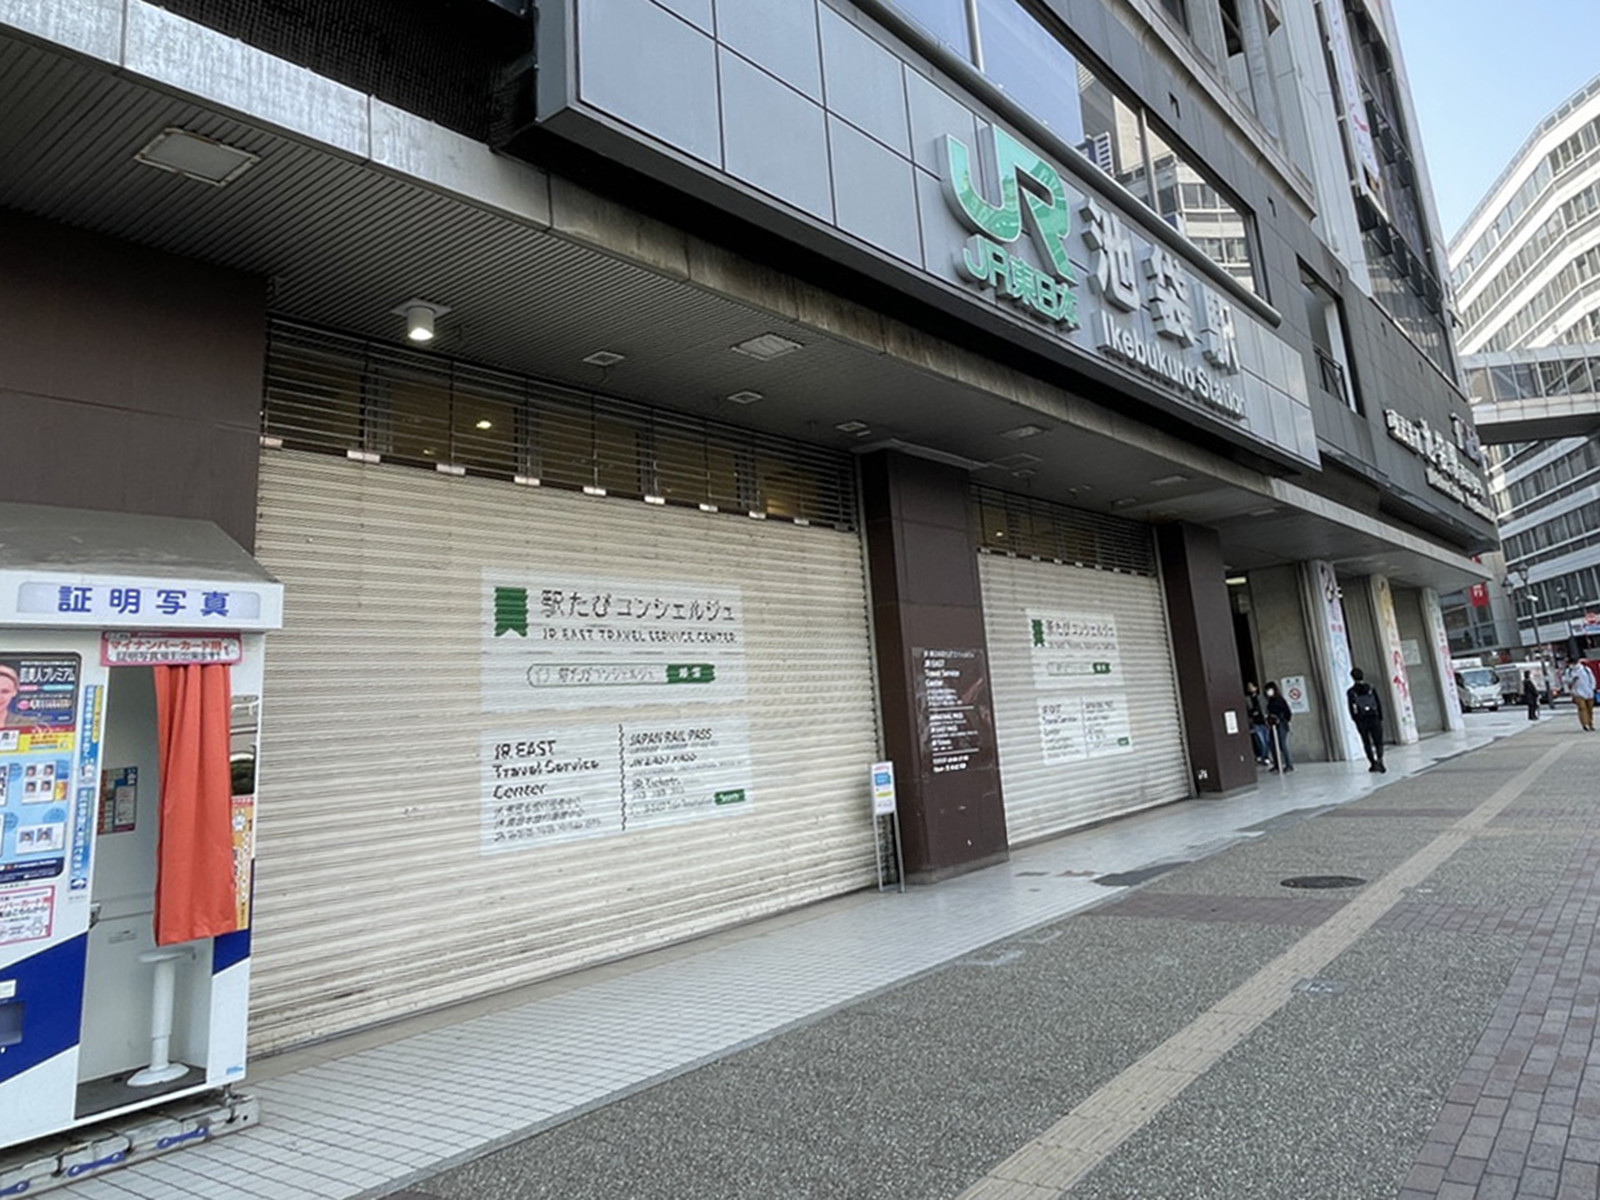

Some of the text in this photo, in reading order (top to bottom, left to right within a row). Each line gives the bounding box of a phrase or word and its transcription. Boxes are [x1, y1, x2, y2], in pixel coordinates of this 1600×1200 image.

[938, 123, 1079, 287] JR
[957, 235, 1081, 331] JR東日本
[1082, 196, 1240, 375] 池袋駅
[1098, 308, 1247, 419] Ikebukuro Station
[58, 585, 230, 617] 証明写真
[541, 588, 735, 622] 駅たびコンシェルジュ
[561, 628, 594, 642] EAST
[599, 629, 647, 642] TRAVEL
[648, 630, 695, 644] SERVICE
[696, 631, 737, 644] CENTER
[515, 739, 557, 758] EAST
[492, 757, 600, 779] Travel Service
[492, 783, 549, 800] Center
